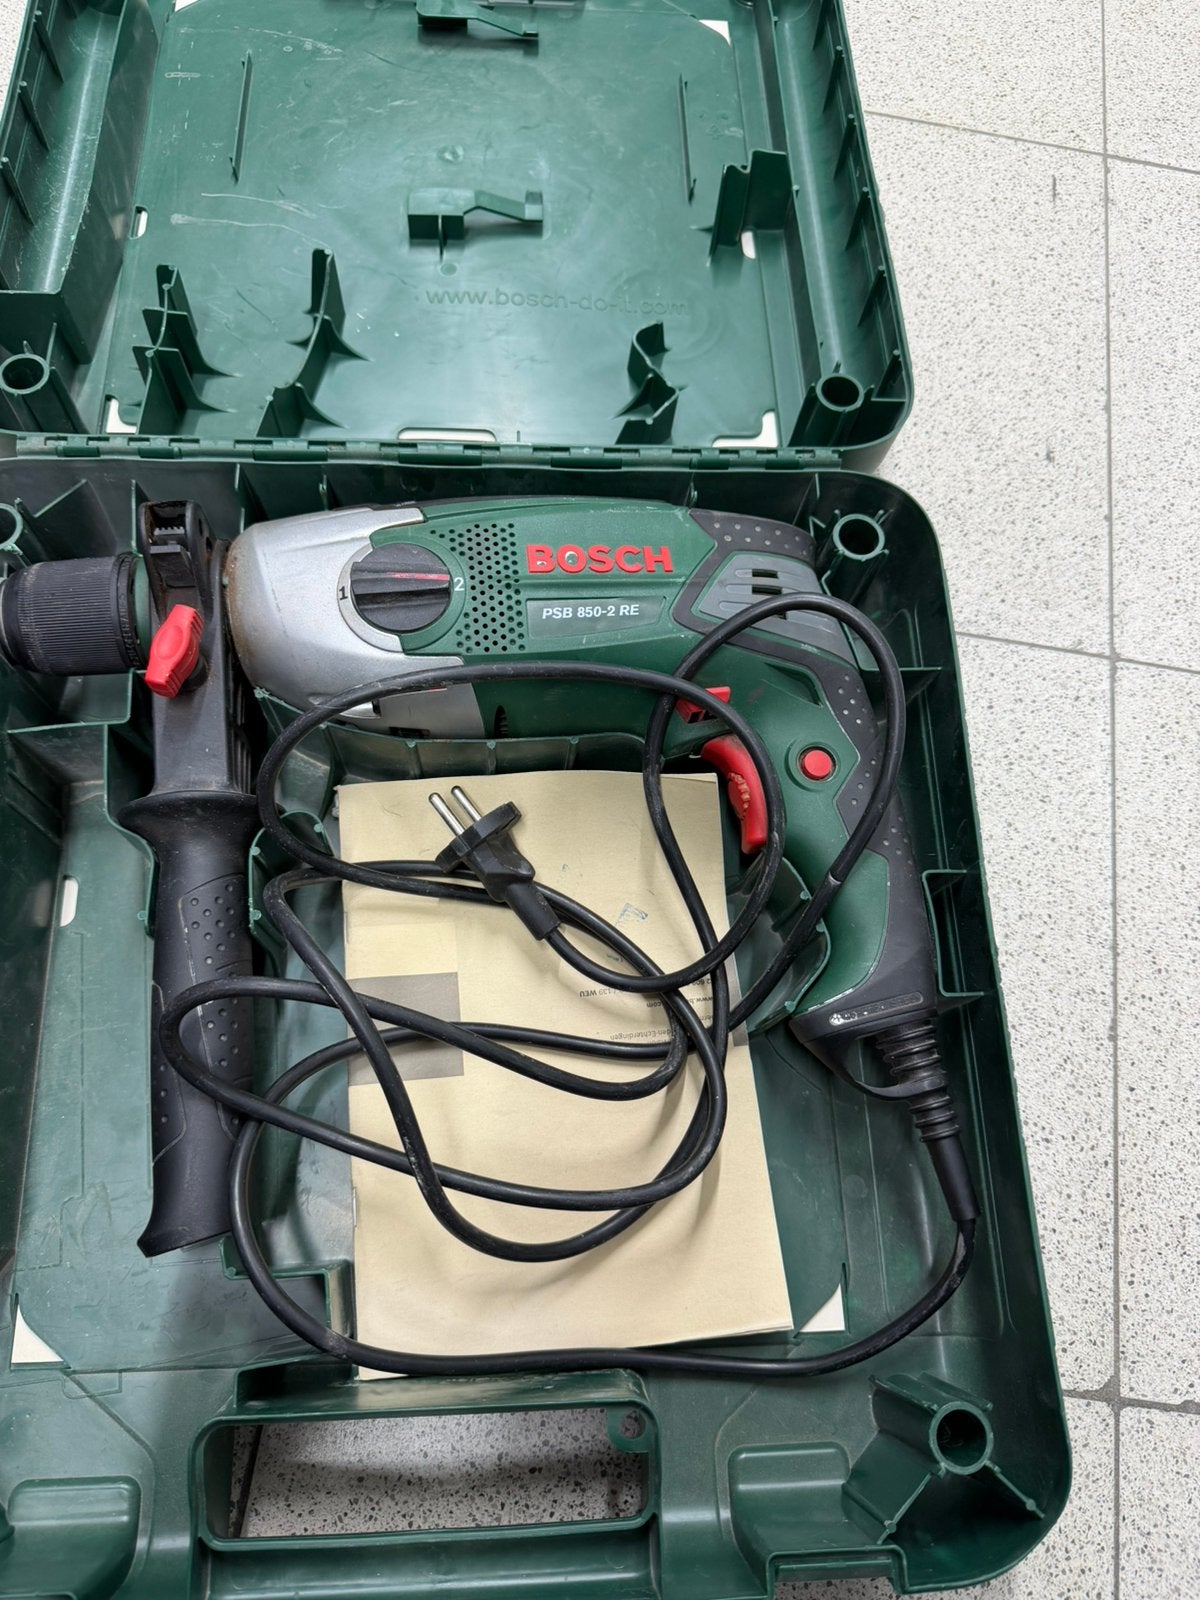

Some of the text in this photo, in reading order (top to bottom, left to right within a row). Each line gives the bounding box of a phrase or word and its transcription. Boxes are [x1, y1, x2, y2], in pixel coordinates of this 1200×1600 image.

[426, 288, 689, 317] www.bosch-do-it.com
[526, 545, 673, 573] BOSCH
[454, 577, 465, 592] 2
[338, 585, 347, 601] 1
[542, 604, 640, 619] PSB 850-2 RE
[579, 989, 598, 998] WEU
[609, 1029, 672, 1041] den-Echterdingen
